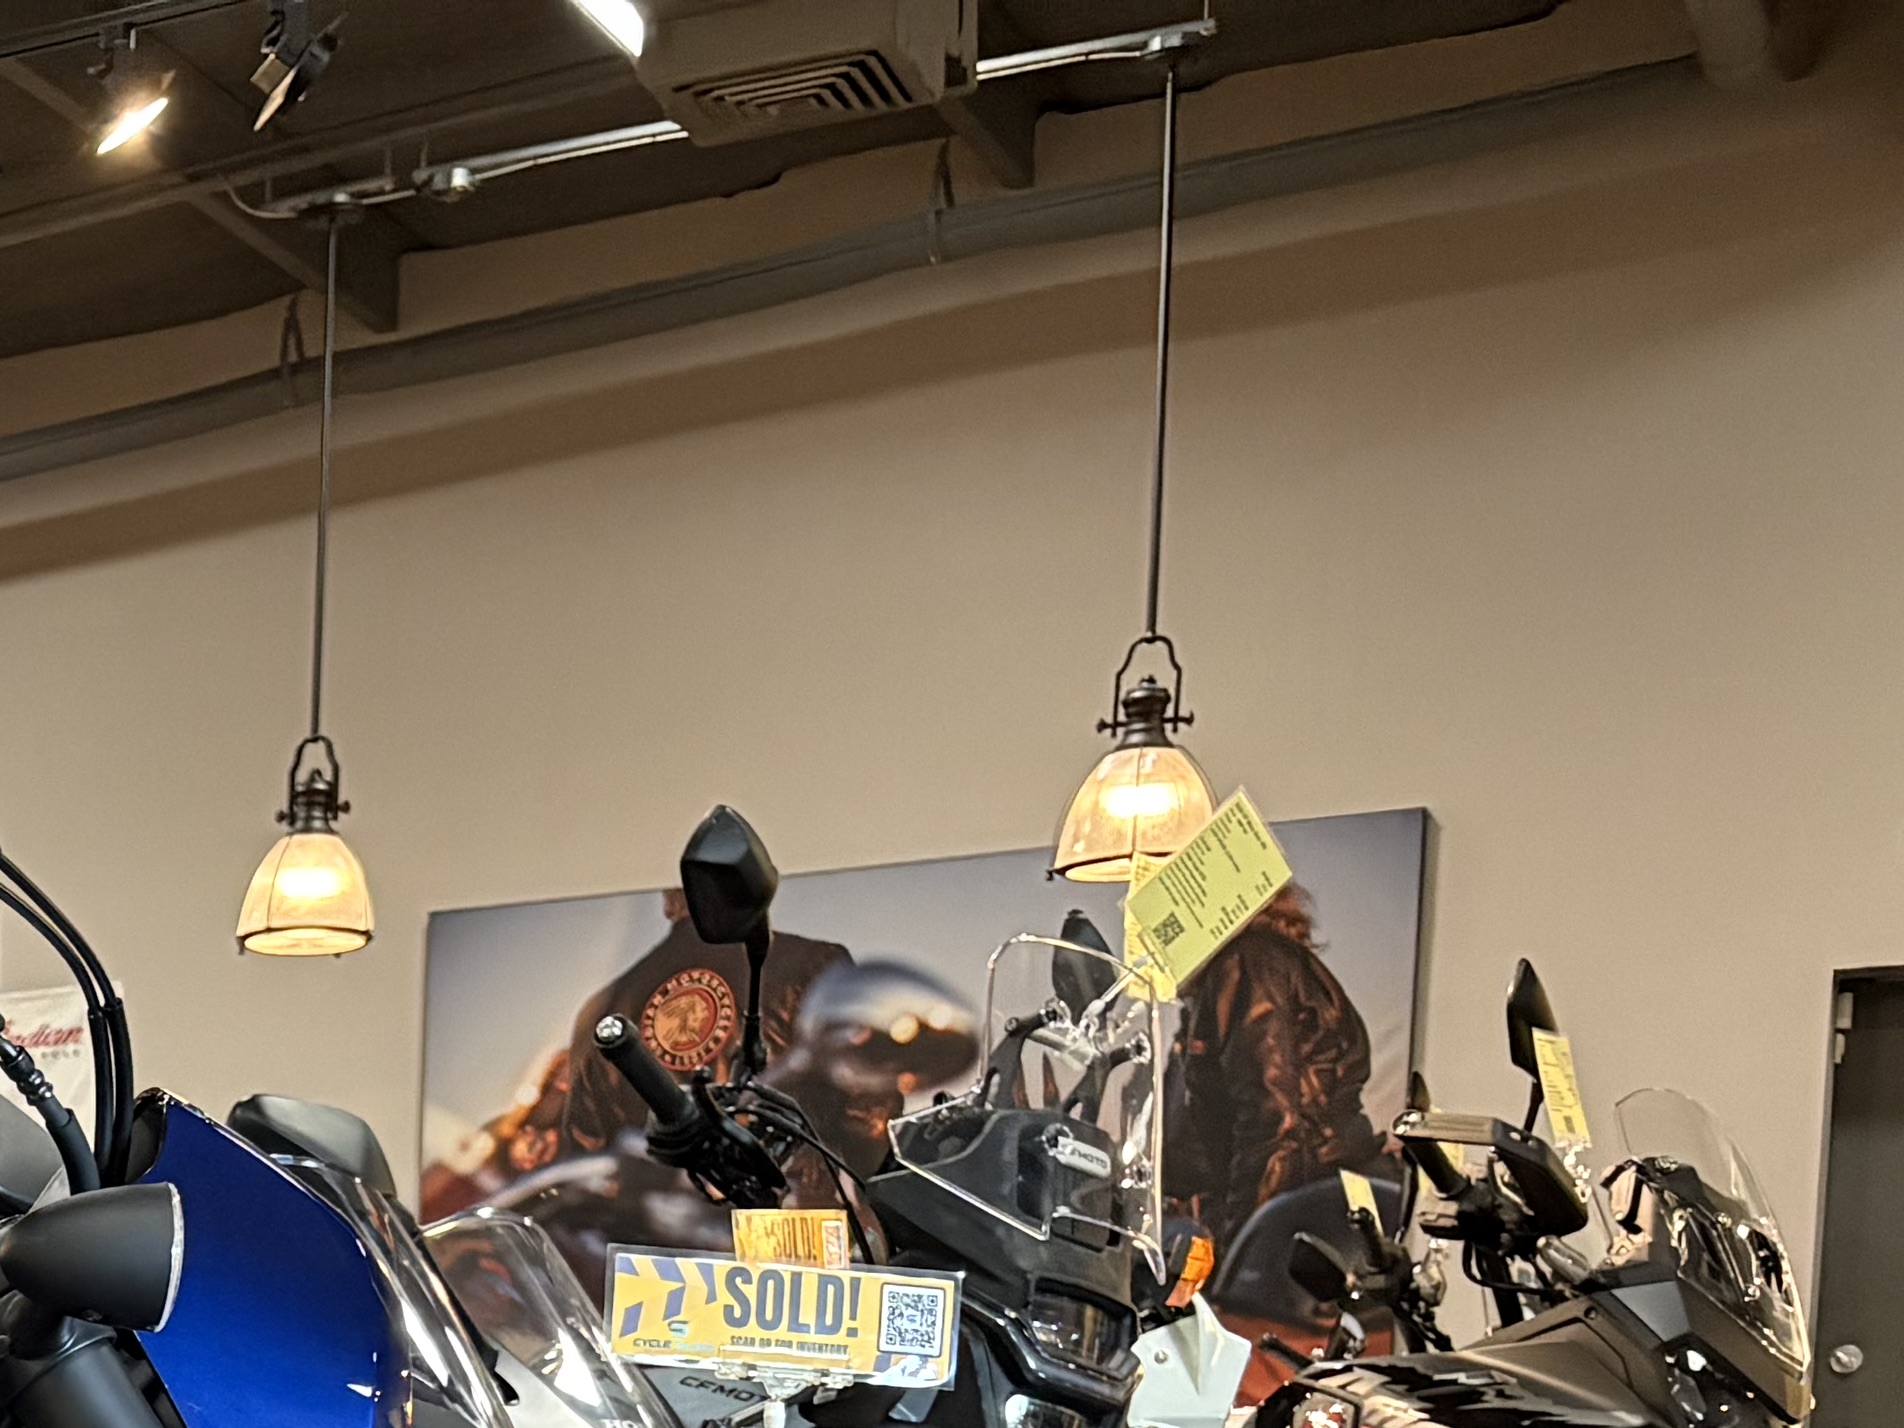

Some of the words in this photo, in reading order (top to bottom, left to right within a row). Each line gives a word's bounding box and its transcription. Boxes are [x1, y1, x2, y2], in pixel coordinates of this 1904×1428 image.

[772, 1216, 818, 1260] SOLD!
[723, 1267, 862, 1338] SOLD!
[633, 1338, 672, 1348] CYCLE
[730, 1335, 756, 1348] SCAN
[679, 1376, 769, 1401] CFMO
